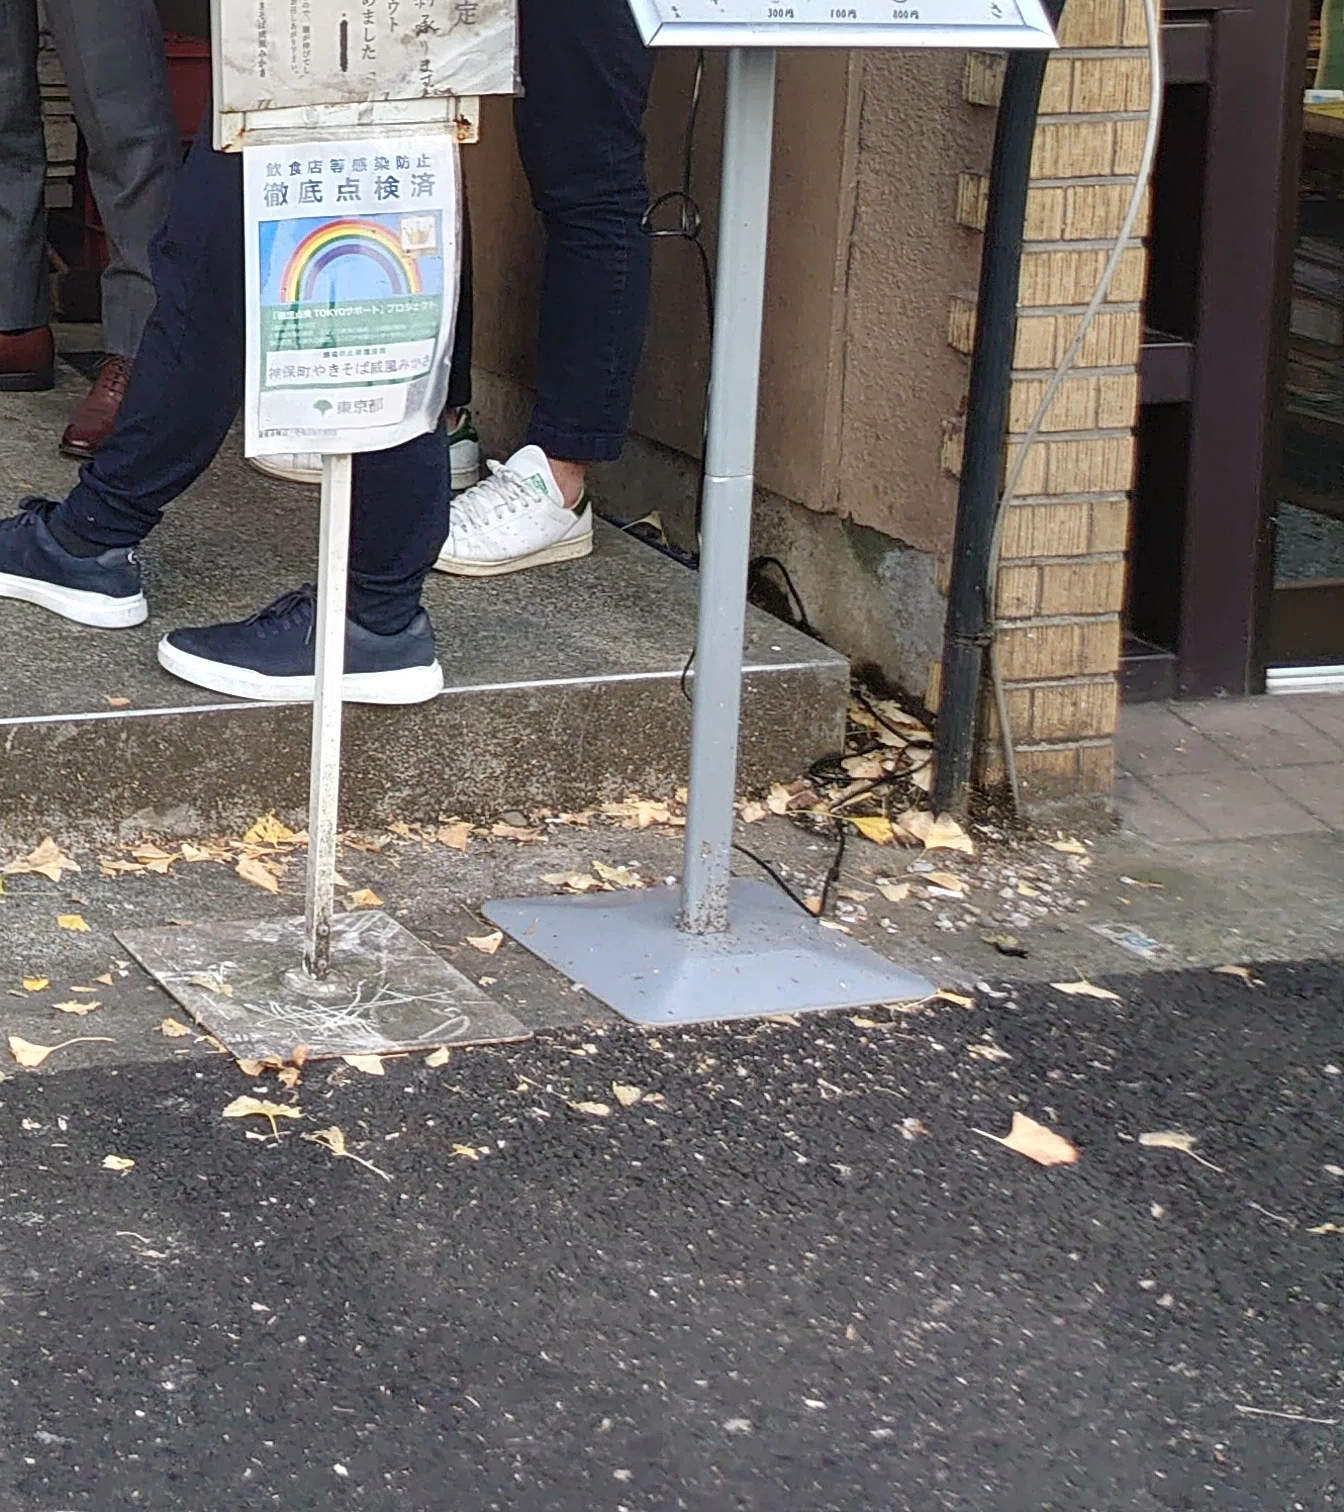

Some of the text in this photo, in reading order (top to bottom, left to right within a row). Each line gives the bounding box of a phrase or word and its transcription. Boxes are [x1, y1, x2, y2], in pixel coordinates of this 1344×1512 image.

[265, 153, 431, 178] 飲食店等感染防止
[263, 172, 436, 208] 徹底点検済
[336, 397, 384, 415] 東京都
